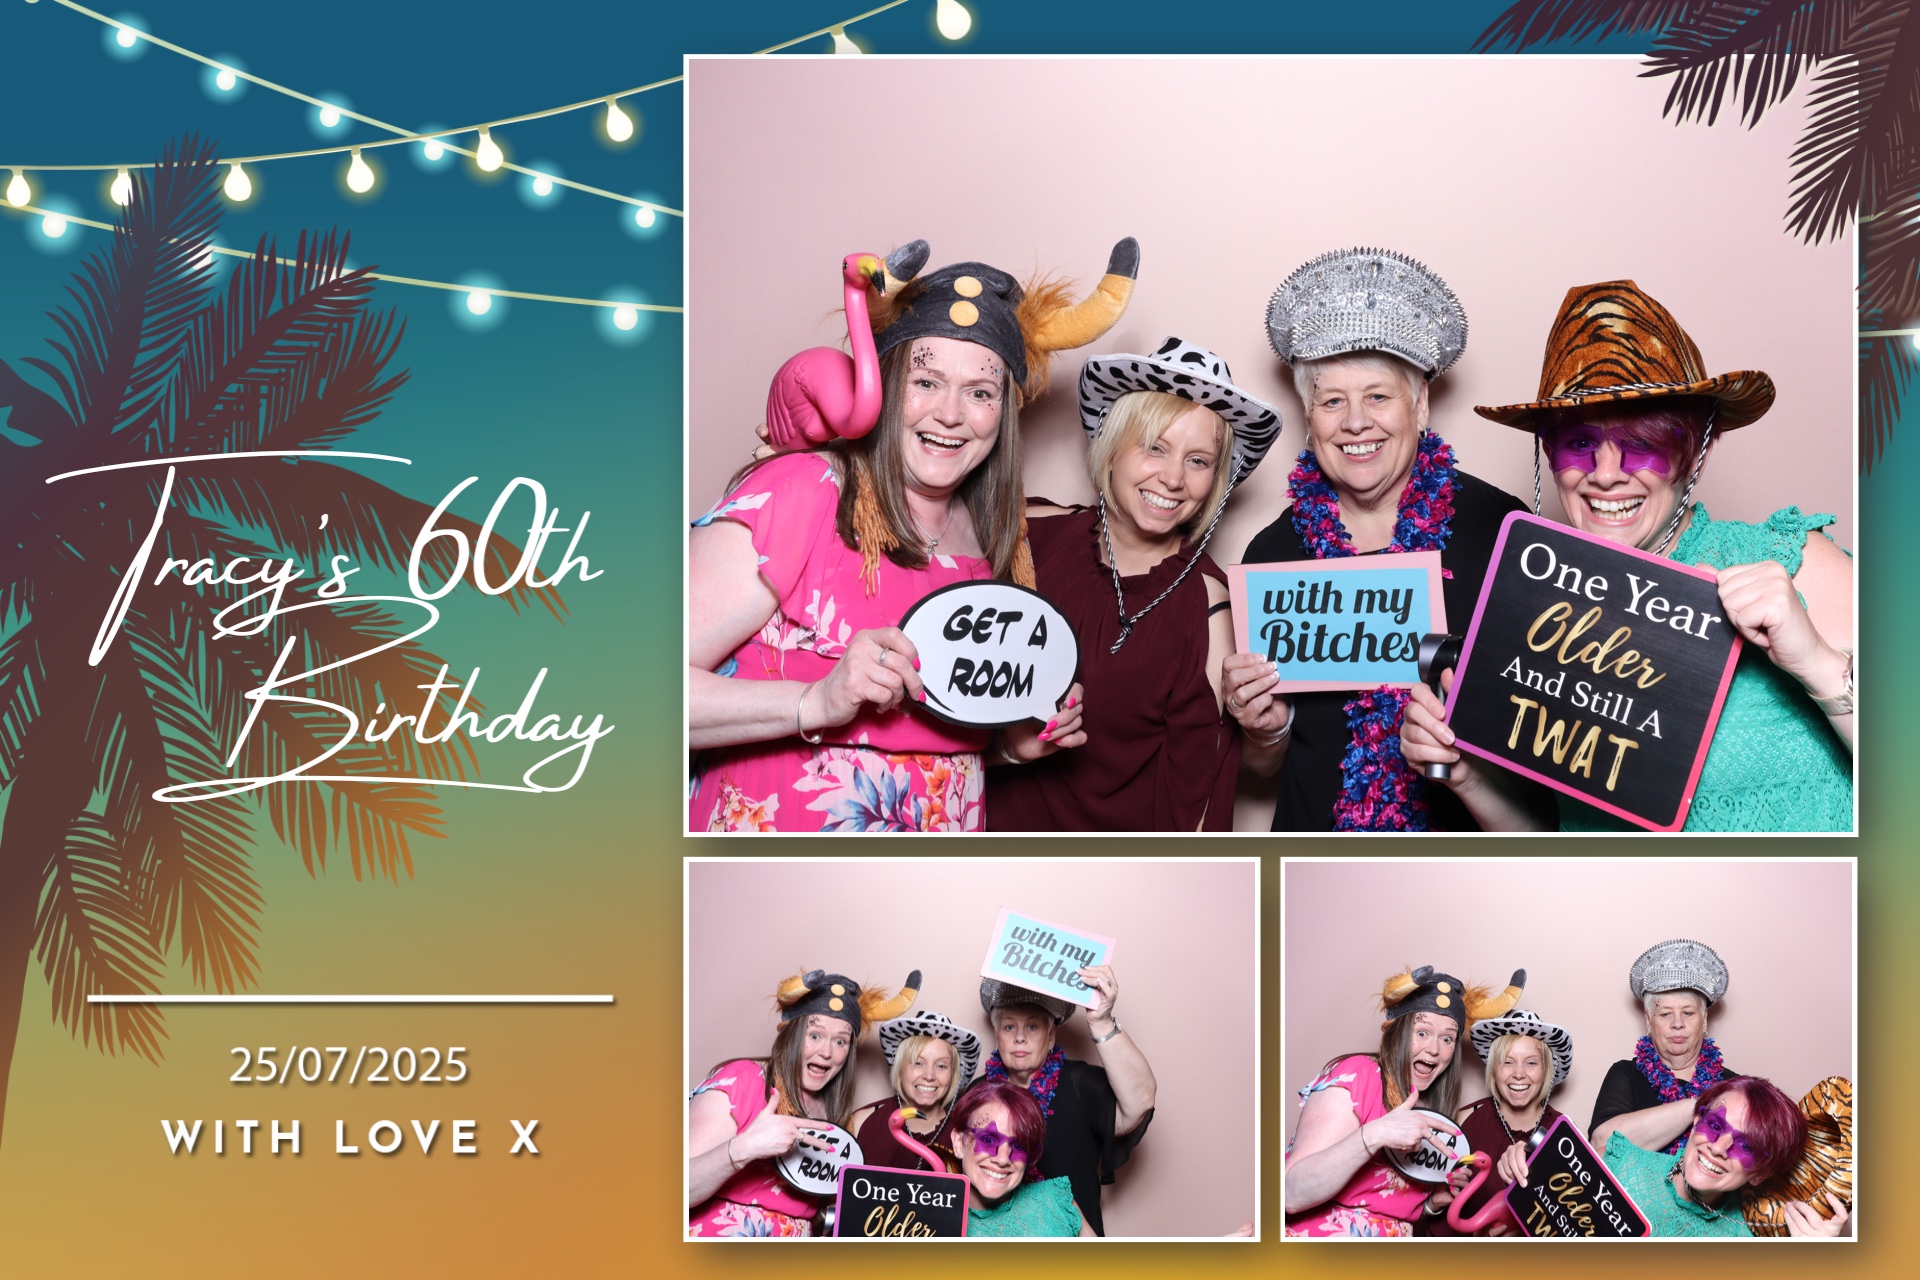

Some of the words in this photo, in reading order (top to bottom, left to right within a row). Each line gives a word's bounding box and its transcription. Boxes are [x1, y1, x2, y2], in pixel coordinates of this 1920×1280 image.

[1262, 580, 1343, 615] with
[1353, 588, 1414, 625] my
[1520, 543, 1609, 601] One
[1624, 573, 1722, 640] Year
[942, 604, 1023, 644] GET
[1027, 614, 1048, 651] A
[1260, 619, 1424, 664] Bitches
[1526, 601, 1667, 690] Older
[947, 657, 1034, 699] ROOM
[1500, 656, 1566, 699] And
[1570, 681, 1634, 725] Still
[1636, 709, 1663, 739] A
[1507, 694, 1640, 792] TWAT
[1010, 925, 1058, 953] with
[1059, 942, 1096, 970] my
[840, 1142, 851, 1160] A
[1447, 1135, 1457, 1149] A
[798, 1156, 841, 1182] ROOM
[1558, 1137, 1591, 1186] One
[1593, 1180, 1632, 1236] Year
[852, 1178, 900, 1202] One
[906, 1182, 957, 1208] Year
[1534, 1185, 1559, 1216] And
[1549, 1173, 1595, 1237] Older
[864, 1204, 937, 1237] Older
